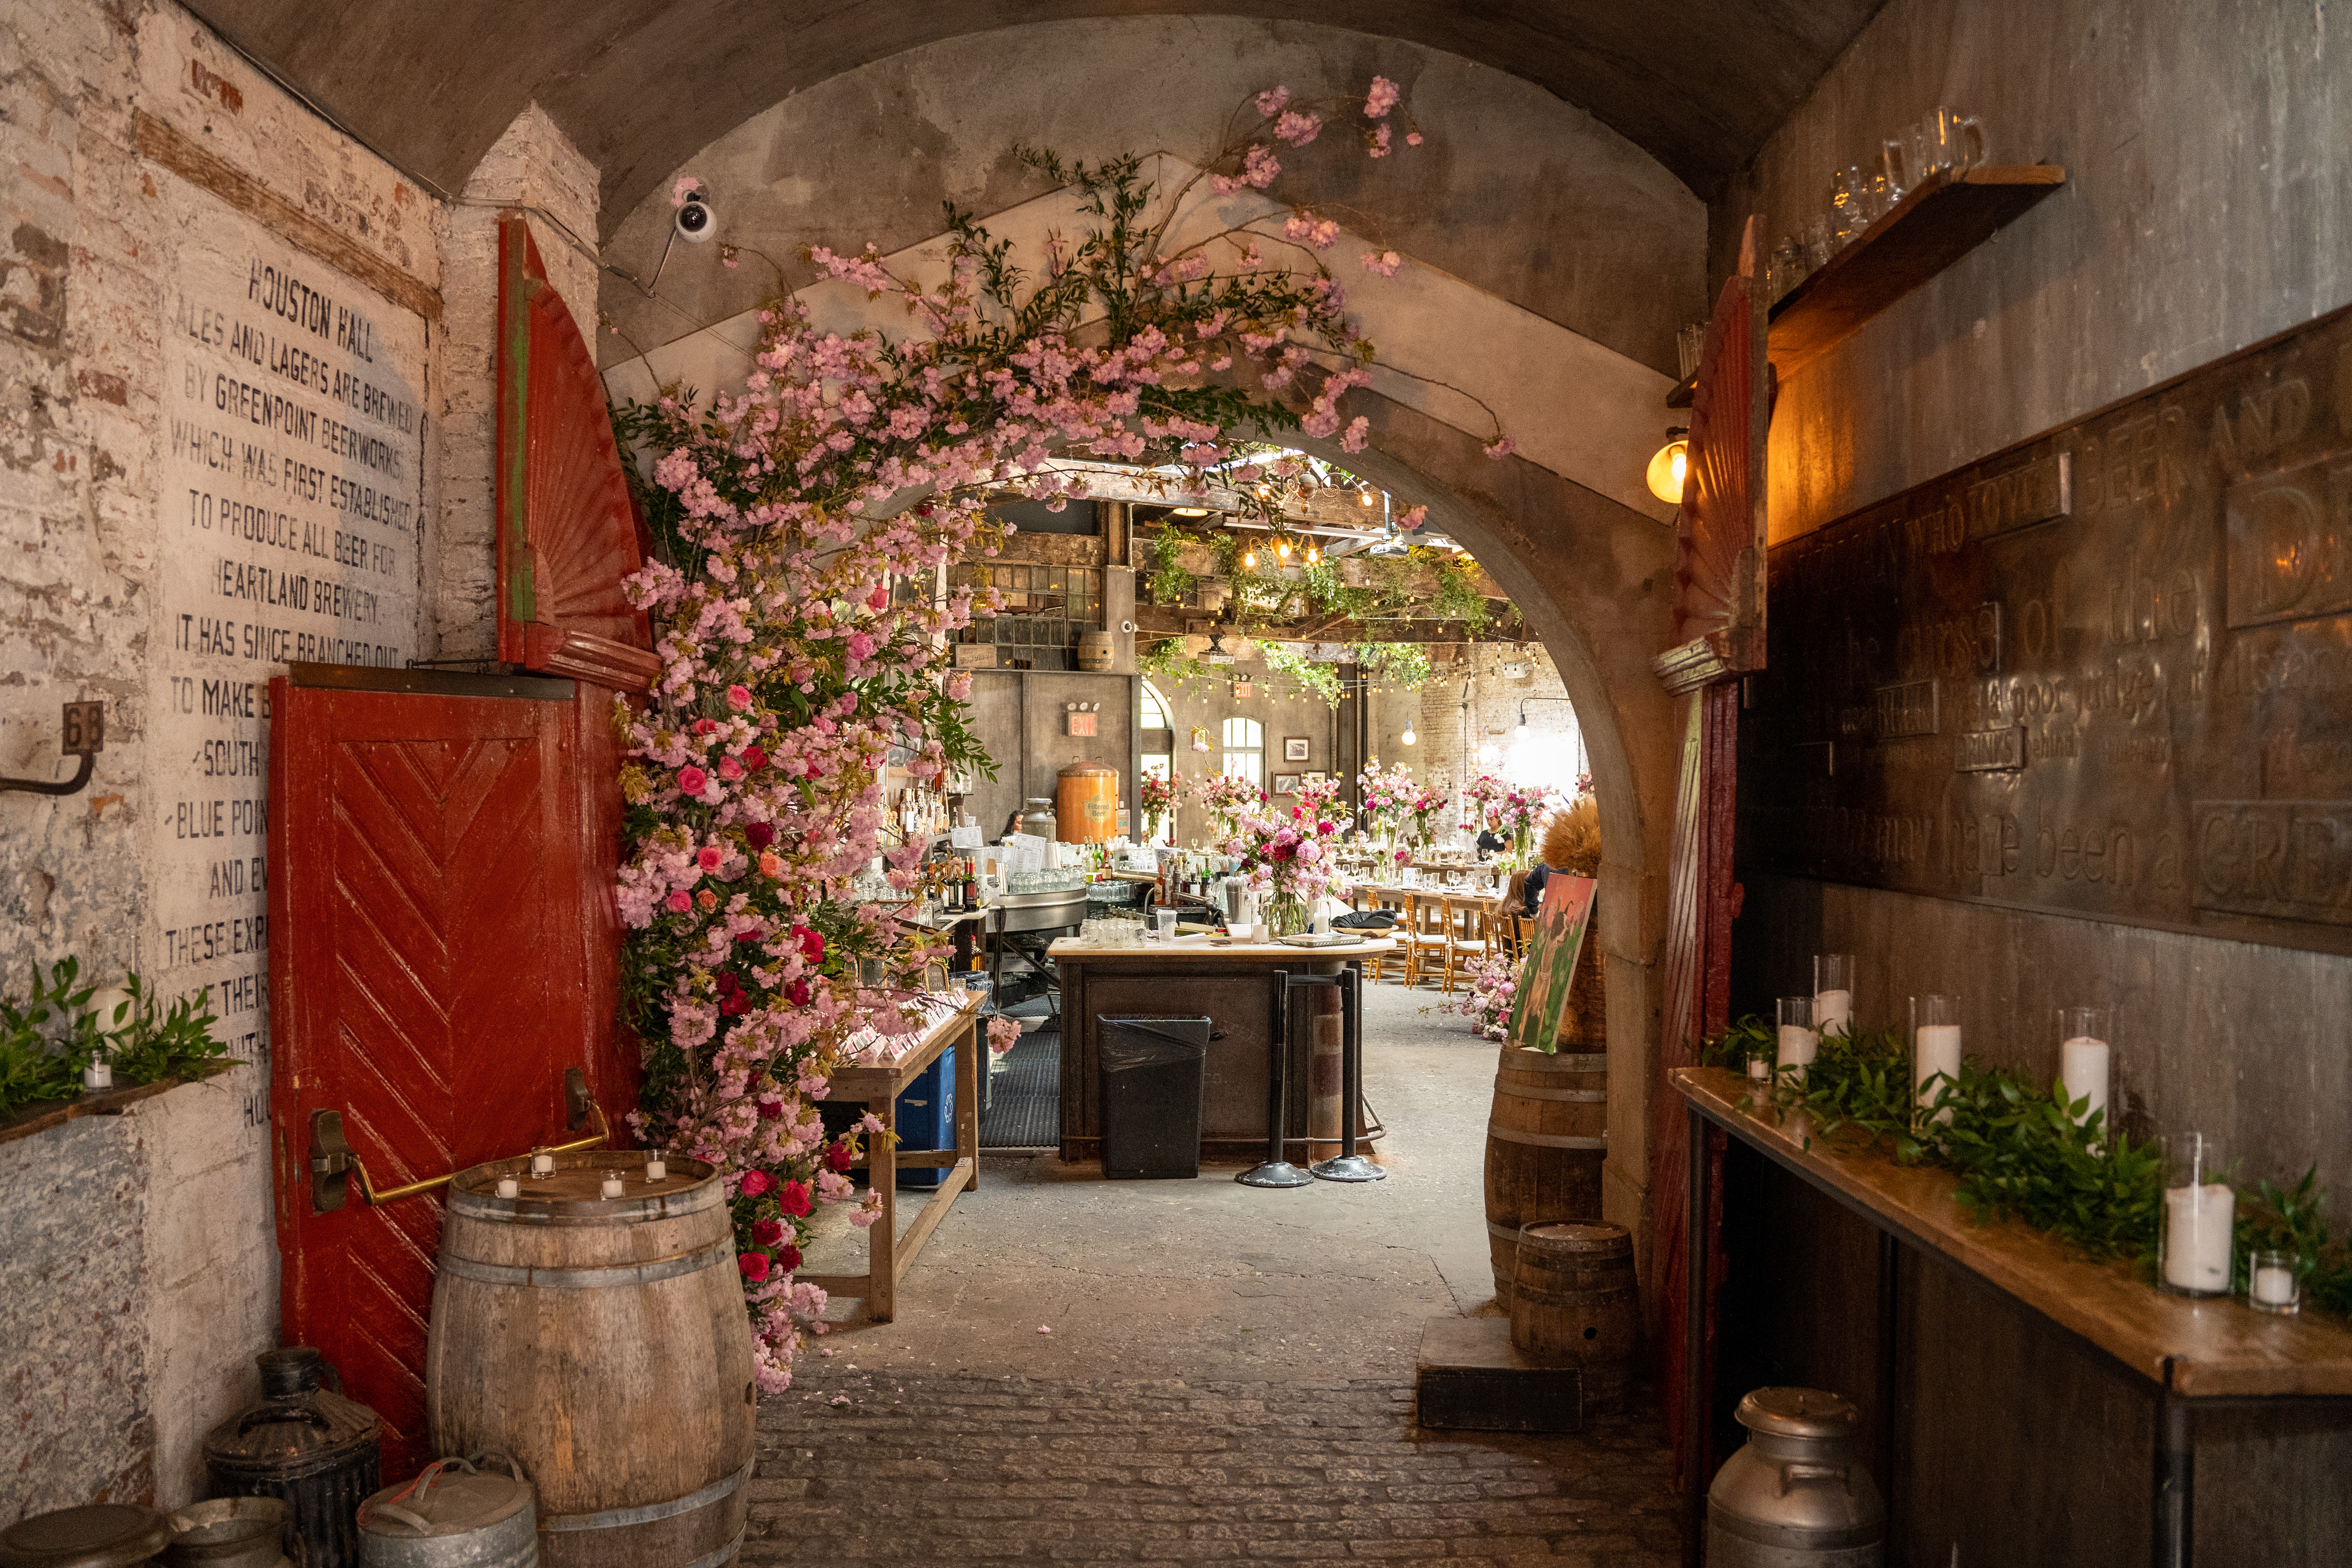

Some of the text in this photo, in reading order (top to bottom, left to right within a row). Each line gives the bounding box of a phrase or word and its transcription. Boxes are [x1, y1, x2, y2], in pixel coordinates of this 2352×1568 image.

[248, 257, 373, 364] HOUSTON HALL
[185, 359, 208, 402] BY
[216, 372, 318, 445] GREENPOINT
[230, 320, 265, 366] AND
[269, 337, 328, 395] LAGERS
[332, 369, 359, 409] ARE
[364, 382, 412, 435] BREWED
[241, 442, 277, 487] WAS
[283, 457, 326, 504] FIRST
[330, 474, 412, 532] ESTABLISHED
[189, 488, 396, 577] TO PRODUCE ALL BEER FOR
[210, 557, 308, 610] HEARTLAND
[175, 612, 193, 652] IT
[199, 616, 235, 657] HAS
[243, 623, 291, 664] SINCE
[298, 632, 370, 668] BRANCHED
[170, 676, 193, 715] TO
[202, 678, 255, 718] MAKE
[1235, 683, 1252, 697] EXIT
[1071, 715, 1096, 736] EXIT
[2036, 793, 2135, 885] been
[2201, 812, 2352, 906] GRE
[210, 859, 243, 899] AND
[165, 921, 225, 968] THESE
